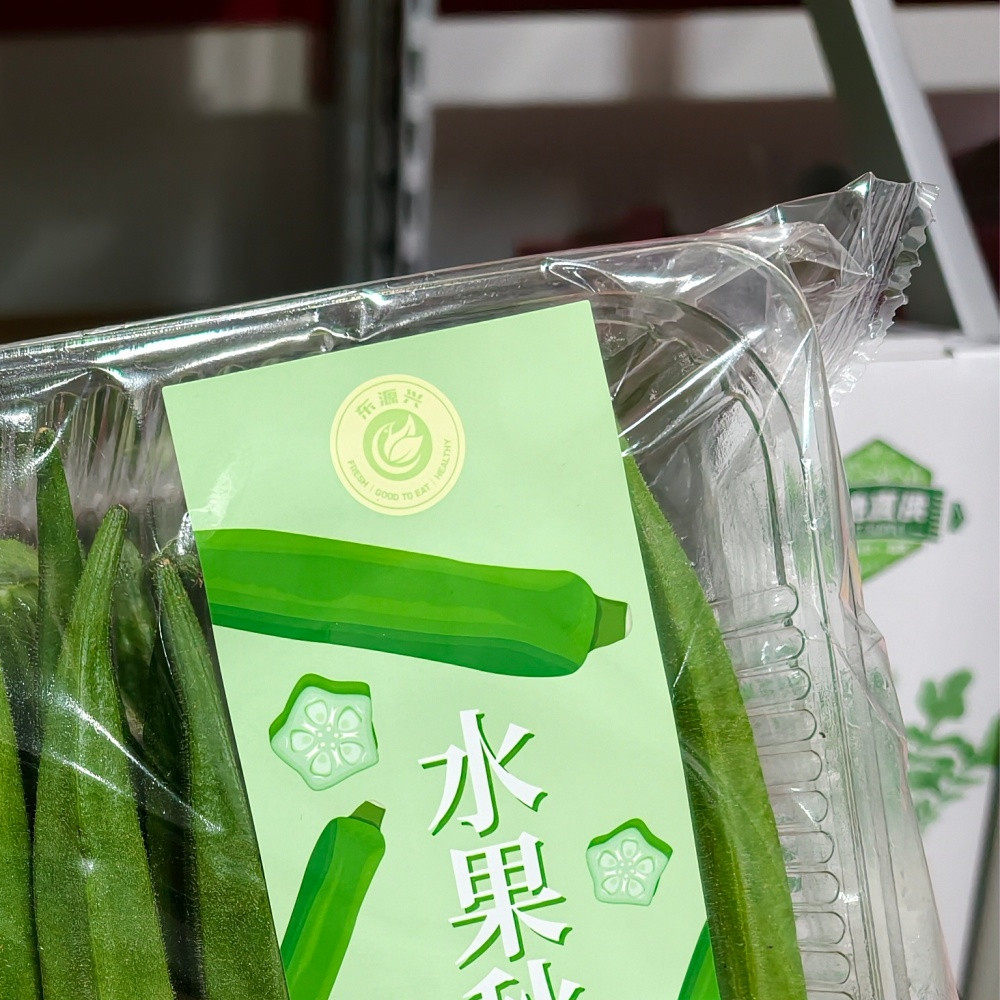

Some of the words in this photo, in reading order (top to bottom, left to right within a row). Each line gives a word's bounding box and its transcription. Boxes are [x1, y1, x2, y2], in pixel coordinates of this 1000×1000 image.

[355, 388, 423, 420] 东源兴
[347, 459, 369, 487] FRESH
[375, 488, 399, 501] GOOD
[402, 491, 413, 500] TO
[415, 483, 431, 498] EAT
[434, 438, 452, 480] HEALTHY
